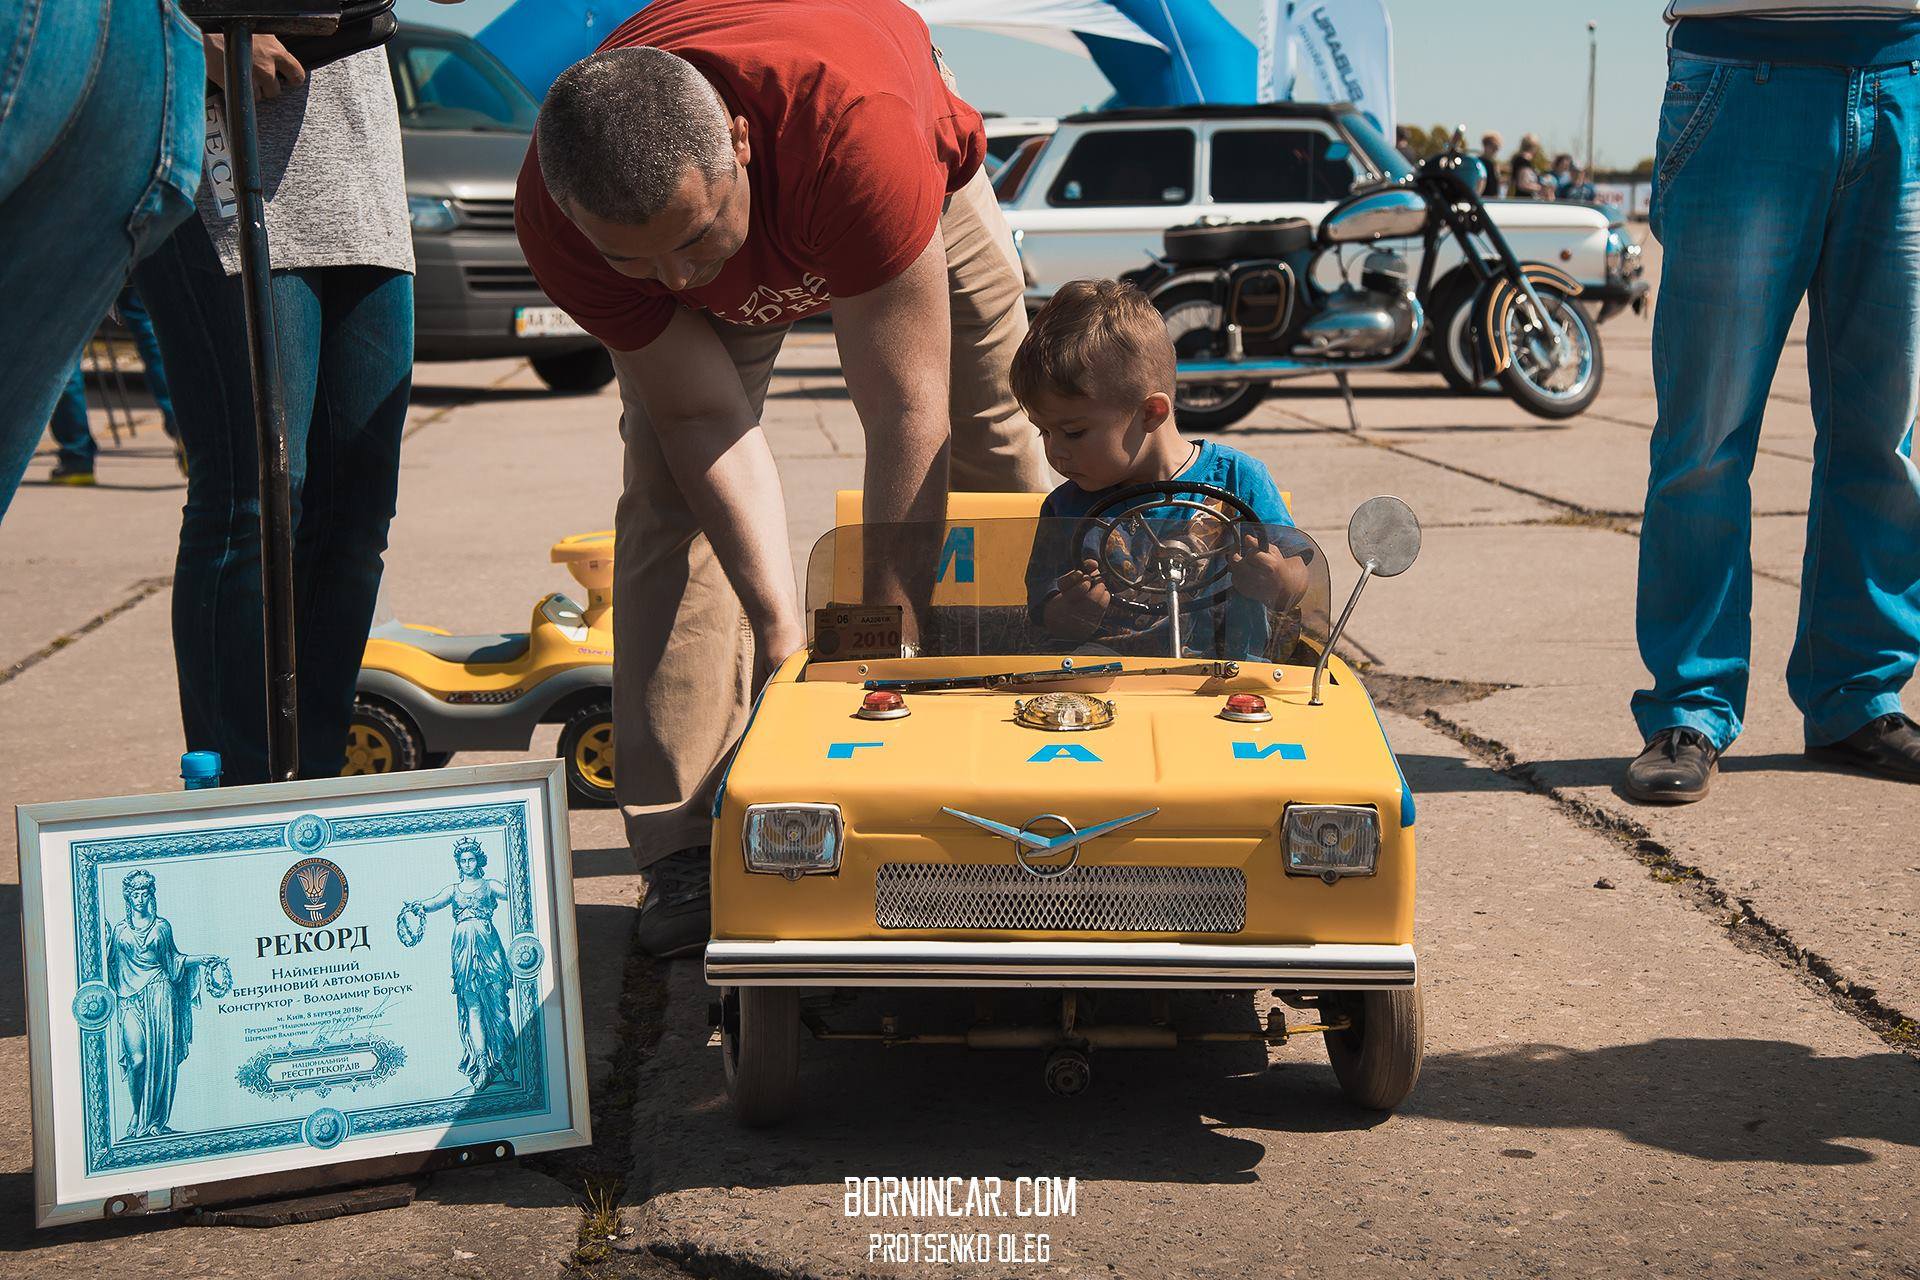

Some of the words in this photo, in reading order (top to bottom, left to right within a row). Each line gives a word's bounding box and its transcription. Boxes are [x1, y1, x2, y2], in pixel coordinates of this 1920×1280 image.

[852, 630, 898, 648] 2010
[826, 742, 884, 760] Г
[256, 926, 371, 958] РЕКОРД
[281, 1068, 314, 1080] РЕЄСТР
[316, 1062, 360, 1074] РЕКОРДІВ
